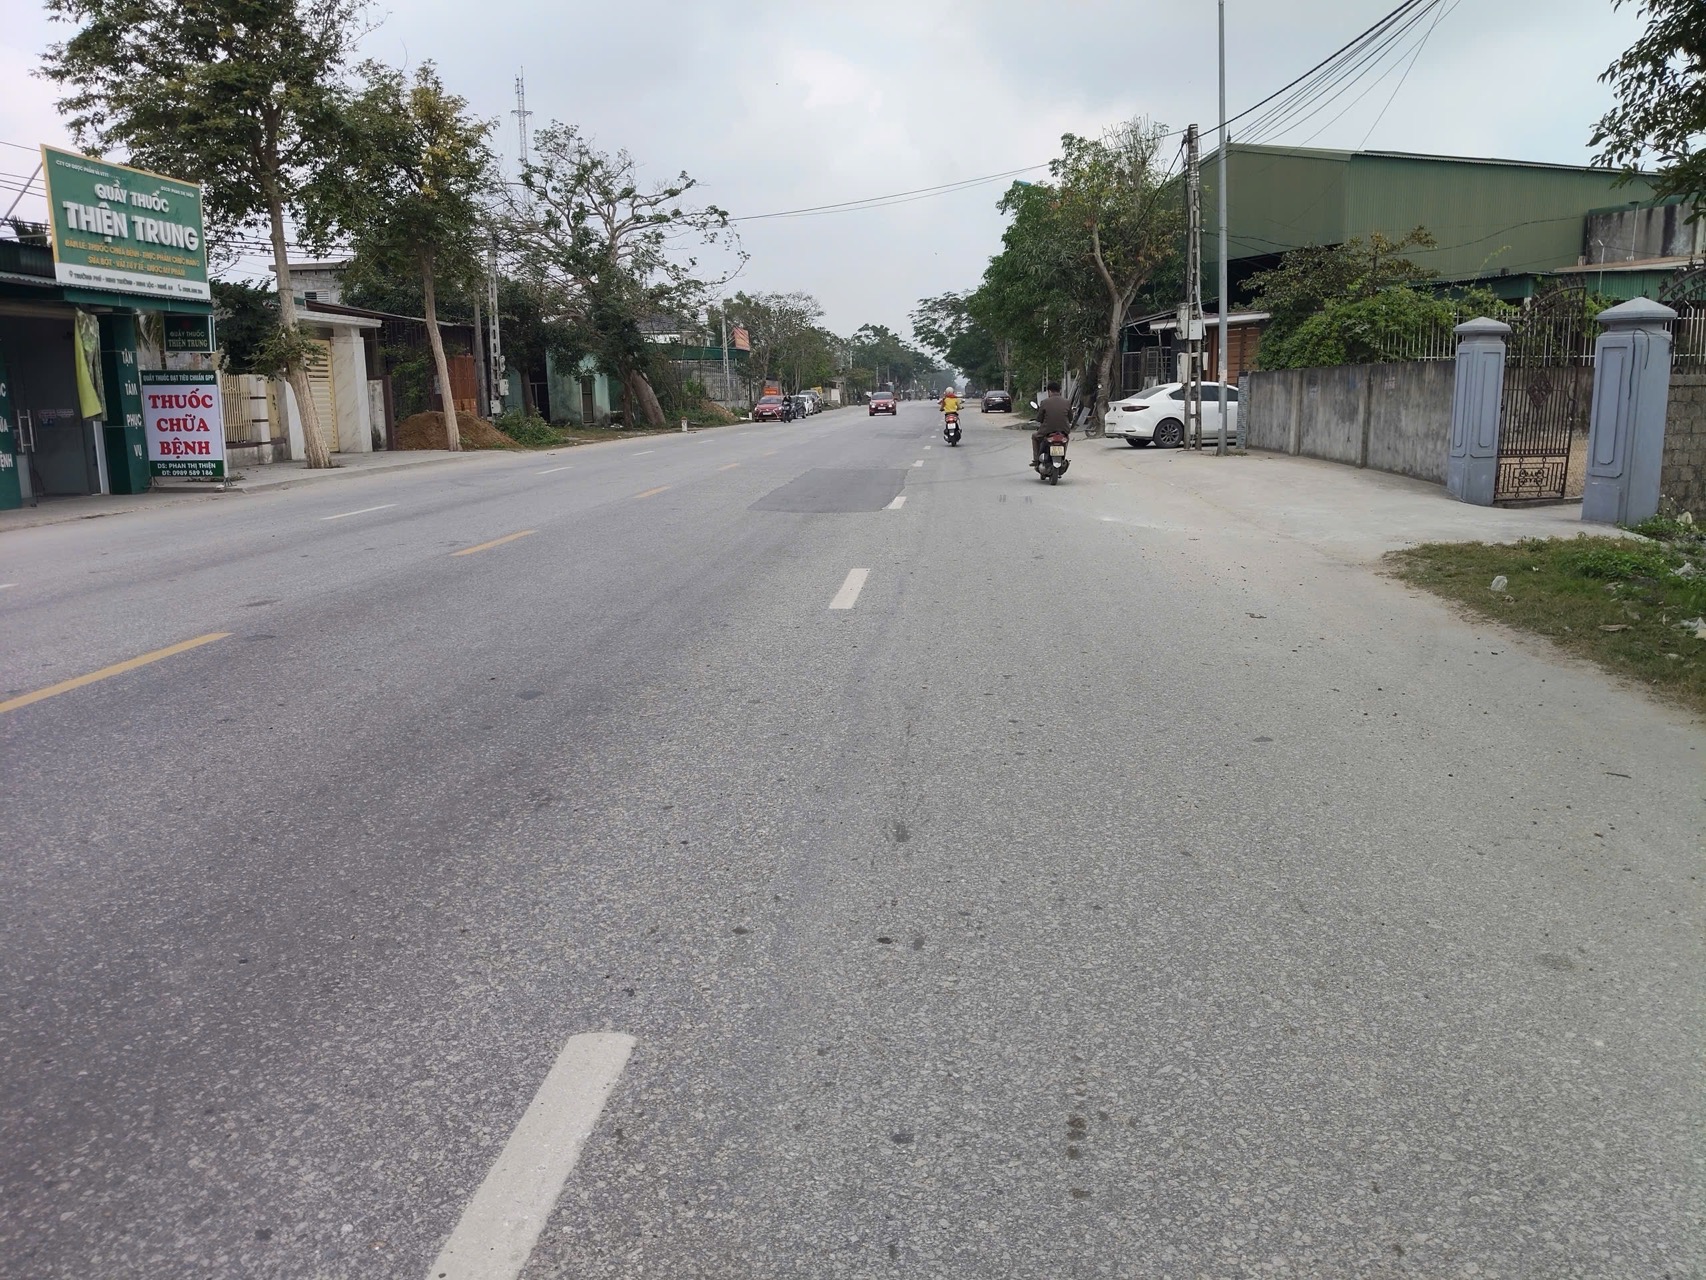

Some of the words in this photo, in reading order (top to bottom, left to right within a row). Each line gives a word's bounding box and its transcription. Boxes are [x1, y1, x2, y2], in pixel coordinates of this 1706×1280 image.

[94, 180, 128, 204] QUẦY
[130, 190, 170, 213] THUỐC
[62, 202, 128, 243] THIỆN
[131, 215, 199, 251] TRUNG
[186, 329, 205, 337] THUỐC
[188, 339, 208, 348] TRUNG
[122, 348, 134, 366] TẬN
[148, 388, 213, 409] THUỐC
[126, 414, 142, 430] PHỤC
[156, 414, 210, 432] CHỮA
[134, 444, 143, 460] VỤ
[159, 437, 211, 459] BỆNH
